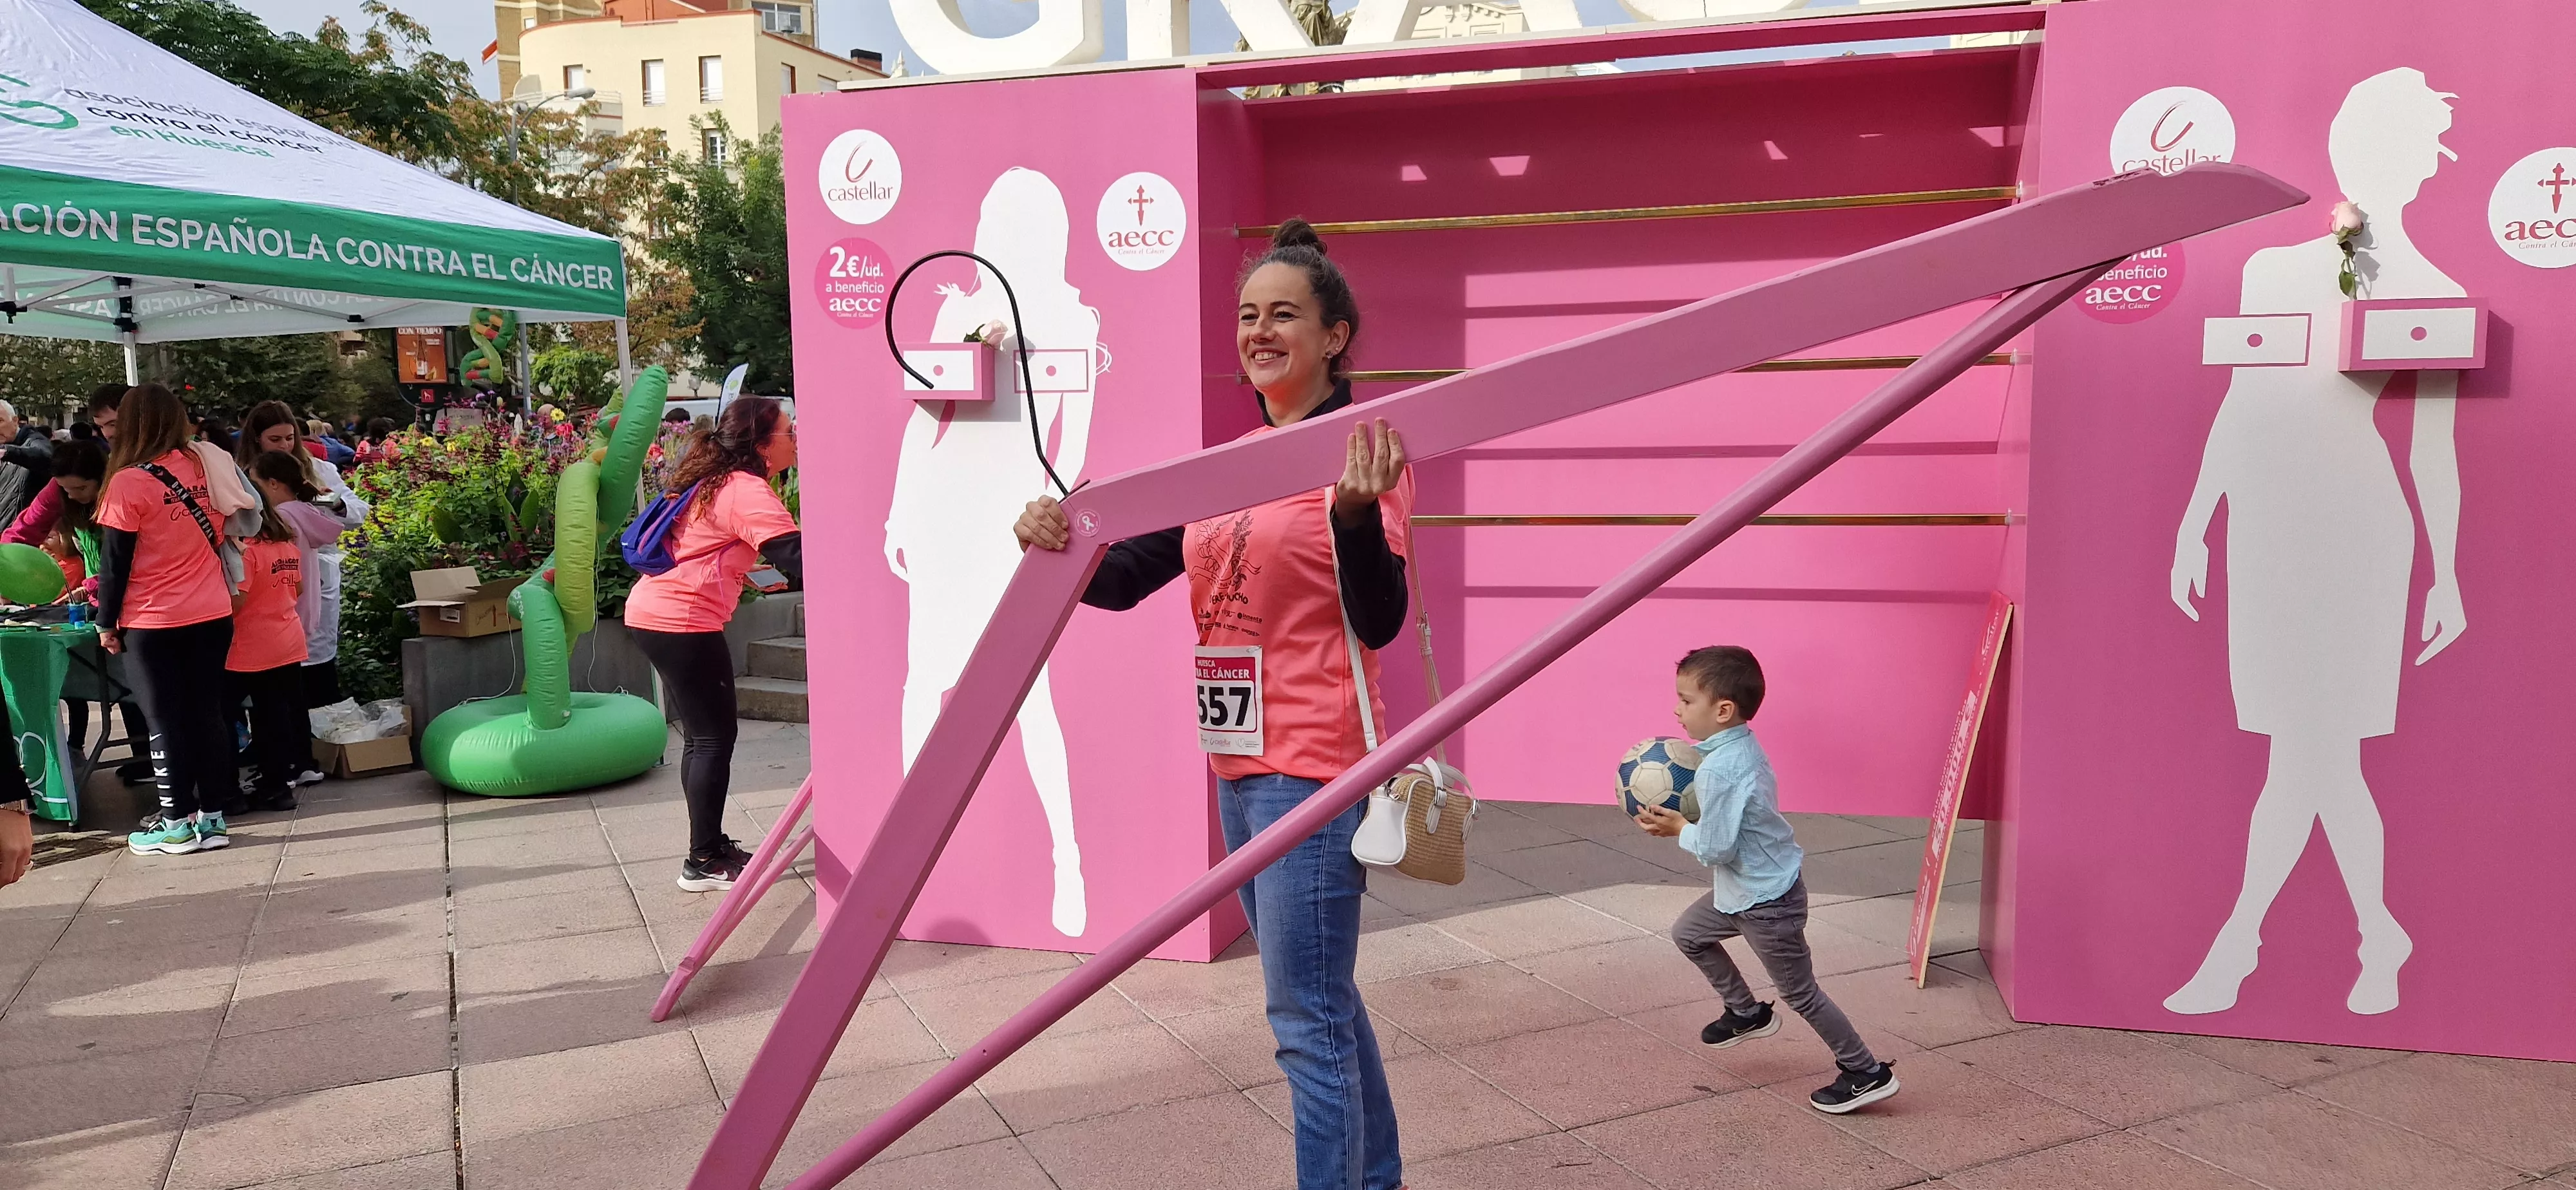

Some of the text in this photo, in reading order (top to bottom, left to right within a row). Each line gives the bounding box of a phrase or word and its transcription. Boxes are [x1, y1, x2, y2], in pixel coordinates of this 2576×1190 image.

[64, 88, 358, 151] asociación española
[87, 107, 323, 154] contra el cáncer
[110, 126, 275, 158] en Huesca
[828, 181, 893, 202] castellar
[132, 213, 331, 262] ESPAÑOLA
[336, 237, 467, 277] CONTRA
[471, 252, 507, 281] EL
[510, 252, 615, 291] CÁNCER
[1108, 230, 1174, 248] aecc
[829, 246, 884, 279] 2€/ud.
[826, 280, 884, 293] a beneficio
[2085, 284, 2162, 304] aecc
[829, 298, 882, 312] aecc
[1203, 668, 1210, 678] EL
[1211, 667, 1250, 679] CÁNCER
[150, 750, 173, 807] NIKE
[1933, 735, 1964, 844] 50.000
